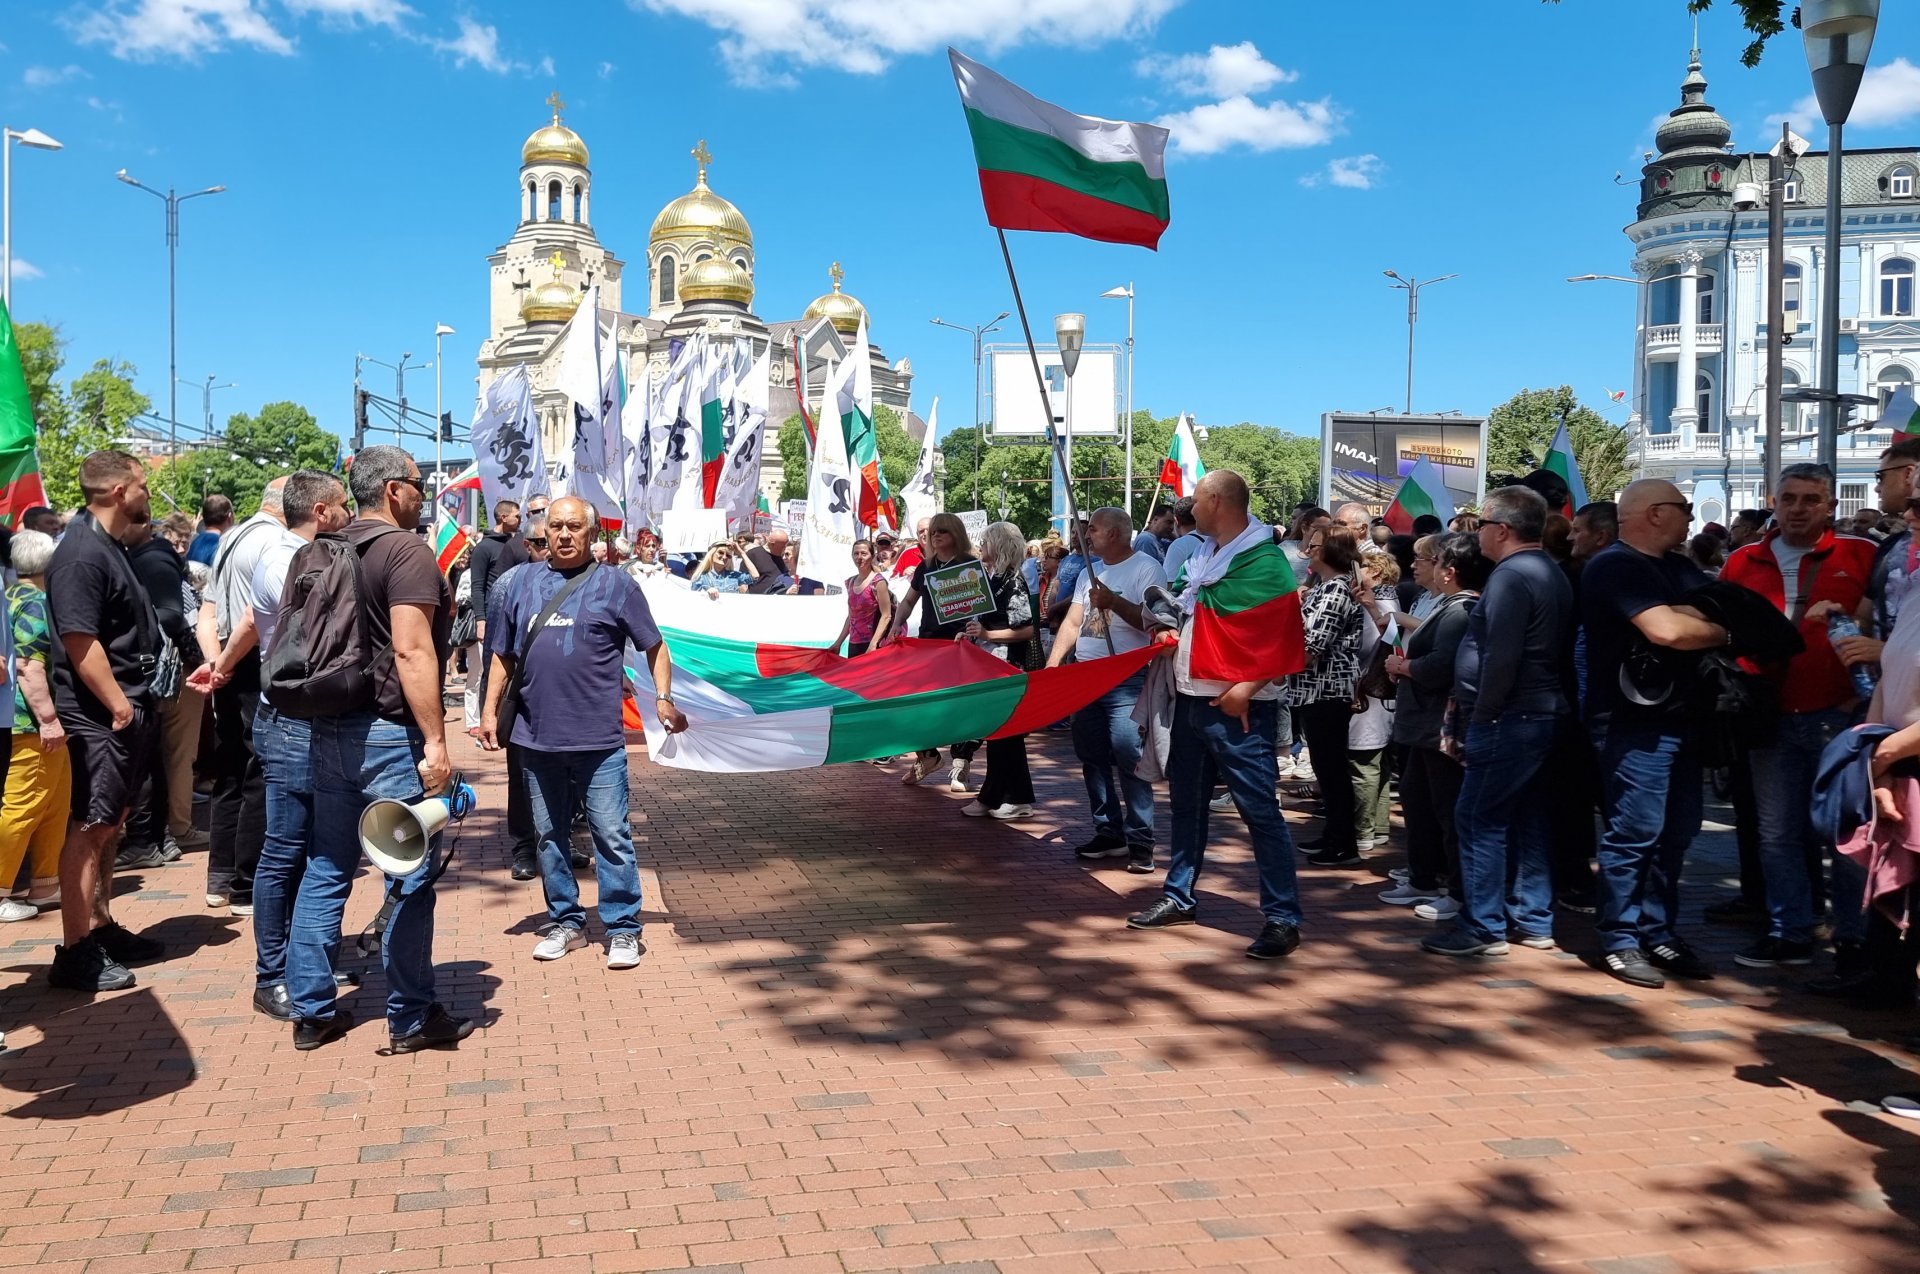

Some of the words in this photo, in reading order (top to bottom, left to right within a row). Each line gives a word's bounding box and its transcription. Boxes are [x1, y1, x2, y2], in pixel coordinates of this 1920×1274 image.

[1334, 441, 1380, 465] IMAX
[1411, 445, 1463, 456] ВЪРХОВНОТО
[938, 575, 967, 589] ЗЛАТЕН
[939, 583, 968, 597] СИМВОЛ
[938, 597, 987, 614] НЕЗАВИСИМОСТ
